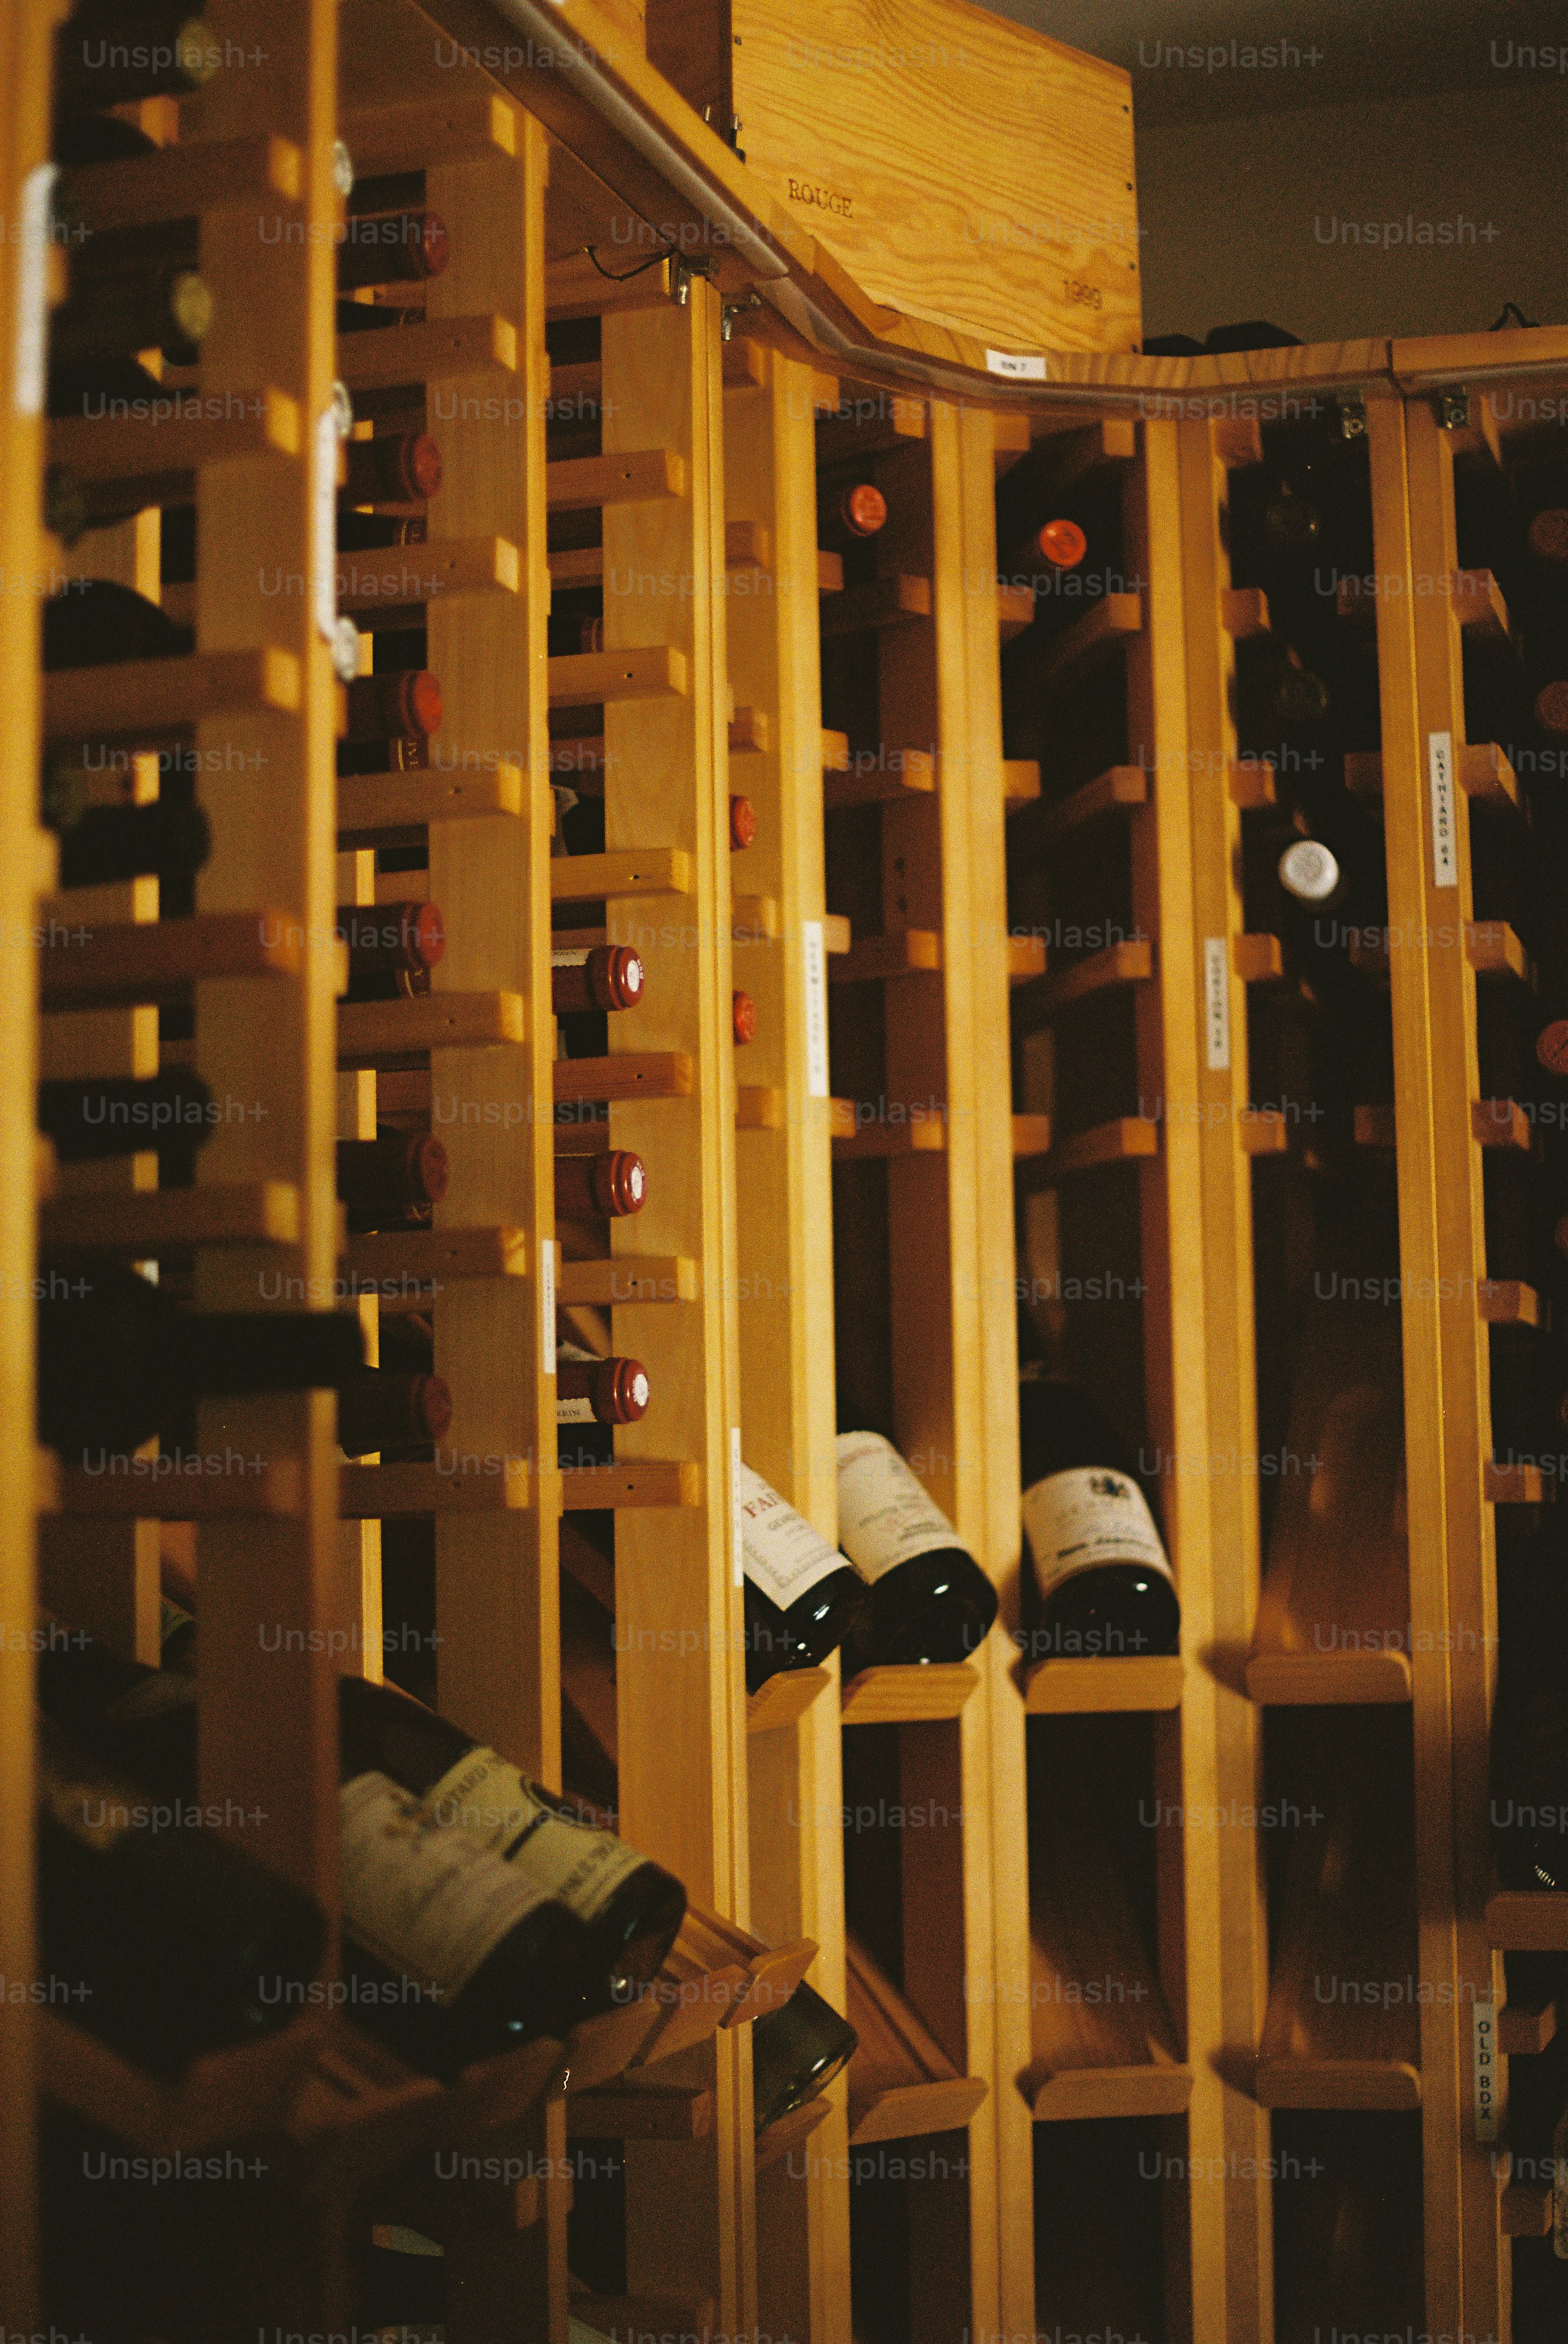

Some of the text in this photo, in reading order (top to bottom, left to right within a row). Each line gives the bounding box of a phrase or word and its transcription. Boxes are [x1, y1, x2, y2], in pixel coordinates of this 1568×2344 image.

[788, 178, 853, 218] ROUGE
[1478, 2020, 1492, 2120] OLD BDX
